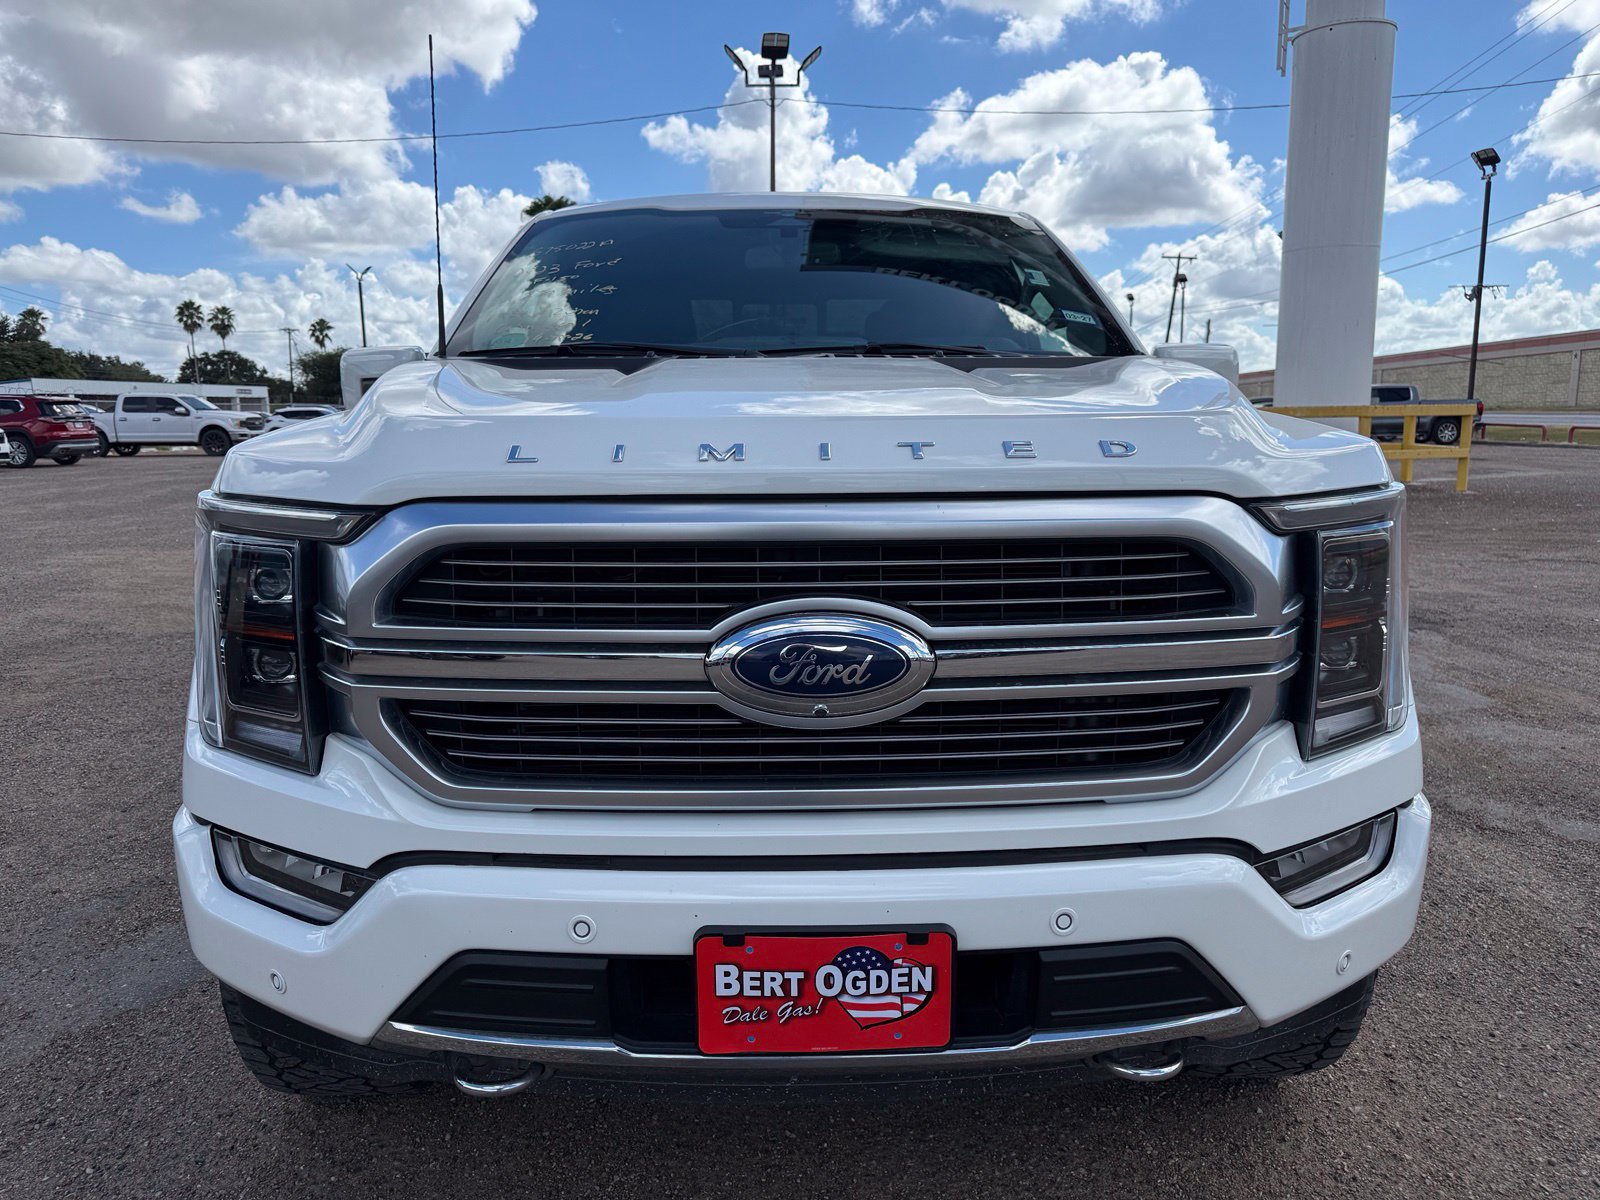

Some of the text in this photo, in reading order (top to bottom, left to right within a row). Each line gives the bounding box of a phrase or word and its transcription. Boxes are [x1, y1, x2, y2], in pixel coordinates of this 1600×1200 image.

[574, 258, 622, 270] Ford
[506, 439, 1139, 463] LIMITED
[769, 643, 874, 686] Ford
[714, 963, 934, 998] BERT OGDEN
[721, 997, 824, 1025] Dale Gas!
